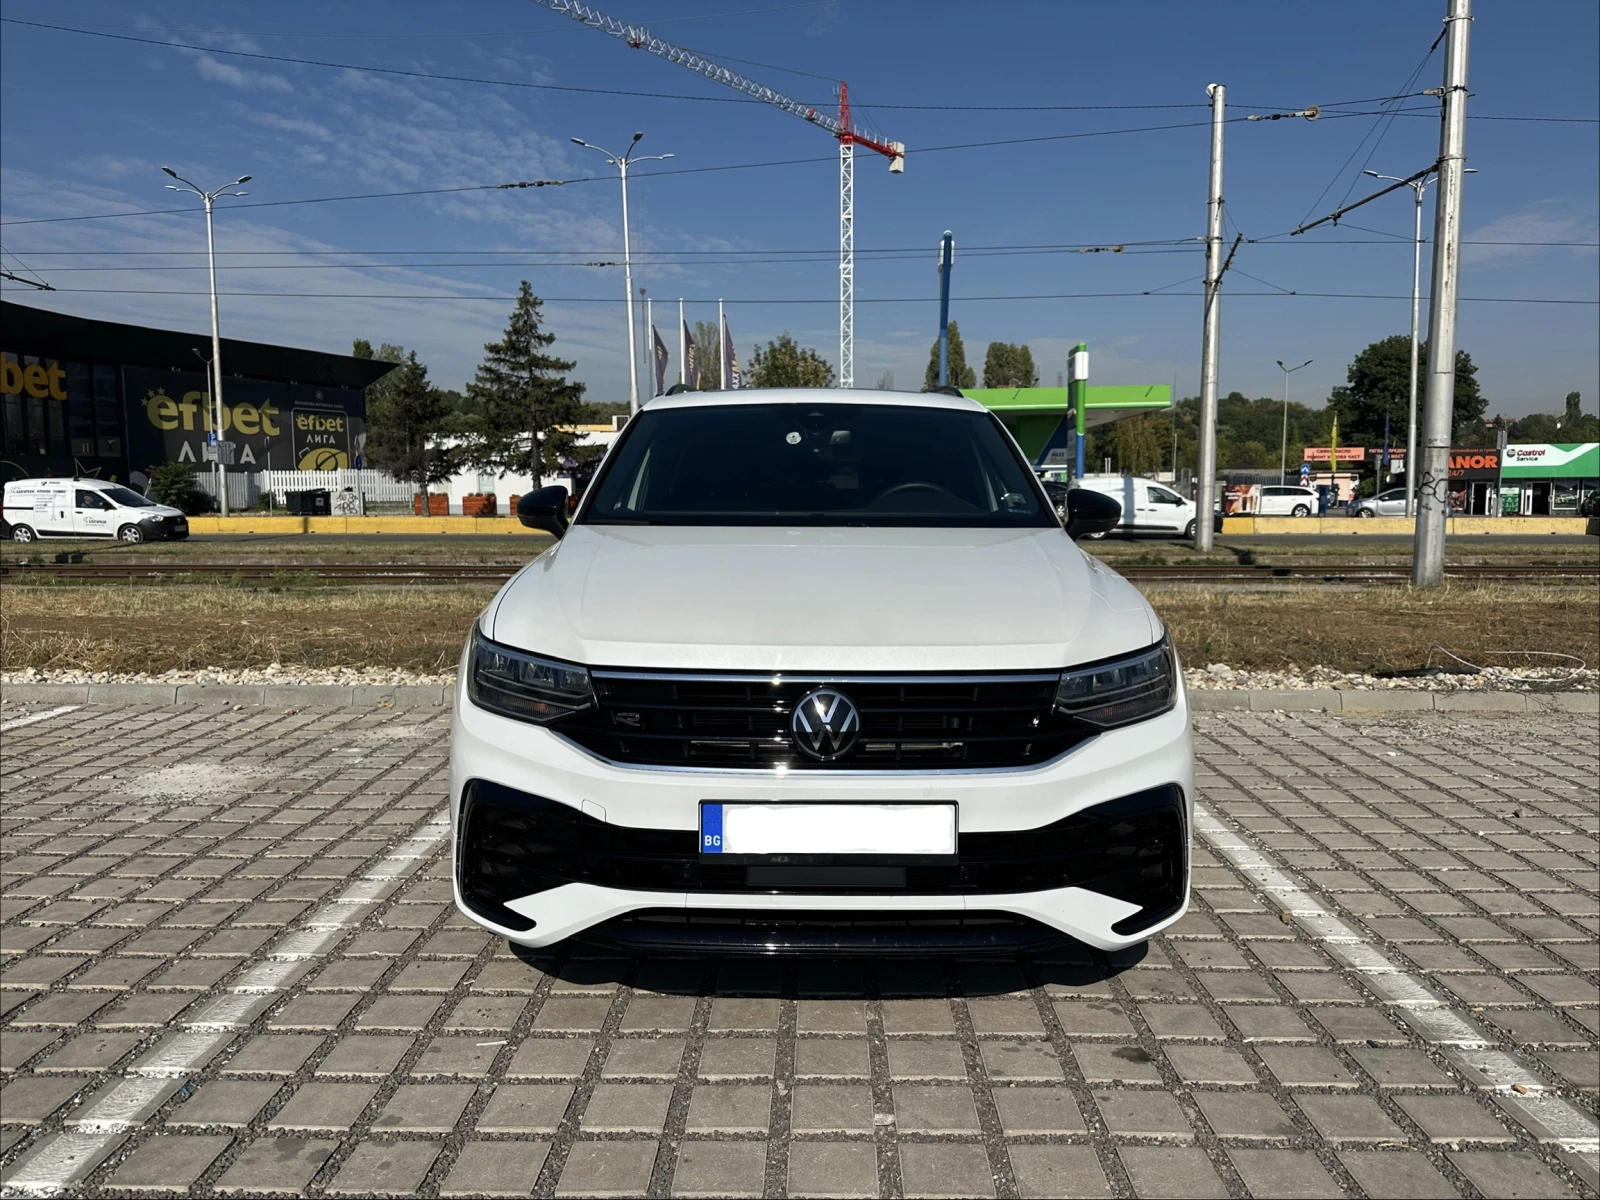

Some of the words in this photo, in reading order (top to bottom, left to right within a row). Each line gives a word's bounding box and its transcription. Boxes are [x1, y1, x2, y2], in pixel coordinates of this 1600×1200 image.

[147, 390, 280, 436] efbet
[296, 414, 344, 432] efbet
[306, 434, 336, 444] ЛИГА
[178, 441, 256, 464] ЛА
[1448, 455, 1498, 469] ANOR
[704, 835, 721, 846] BG
